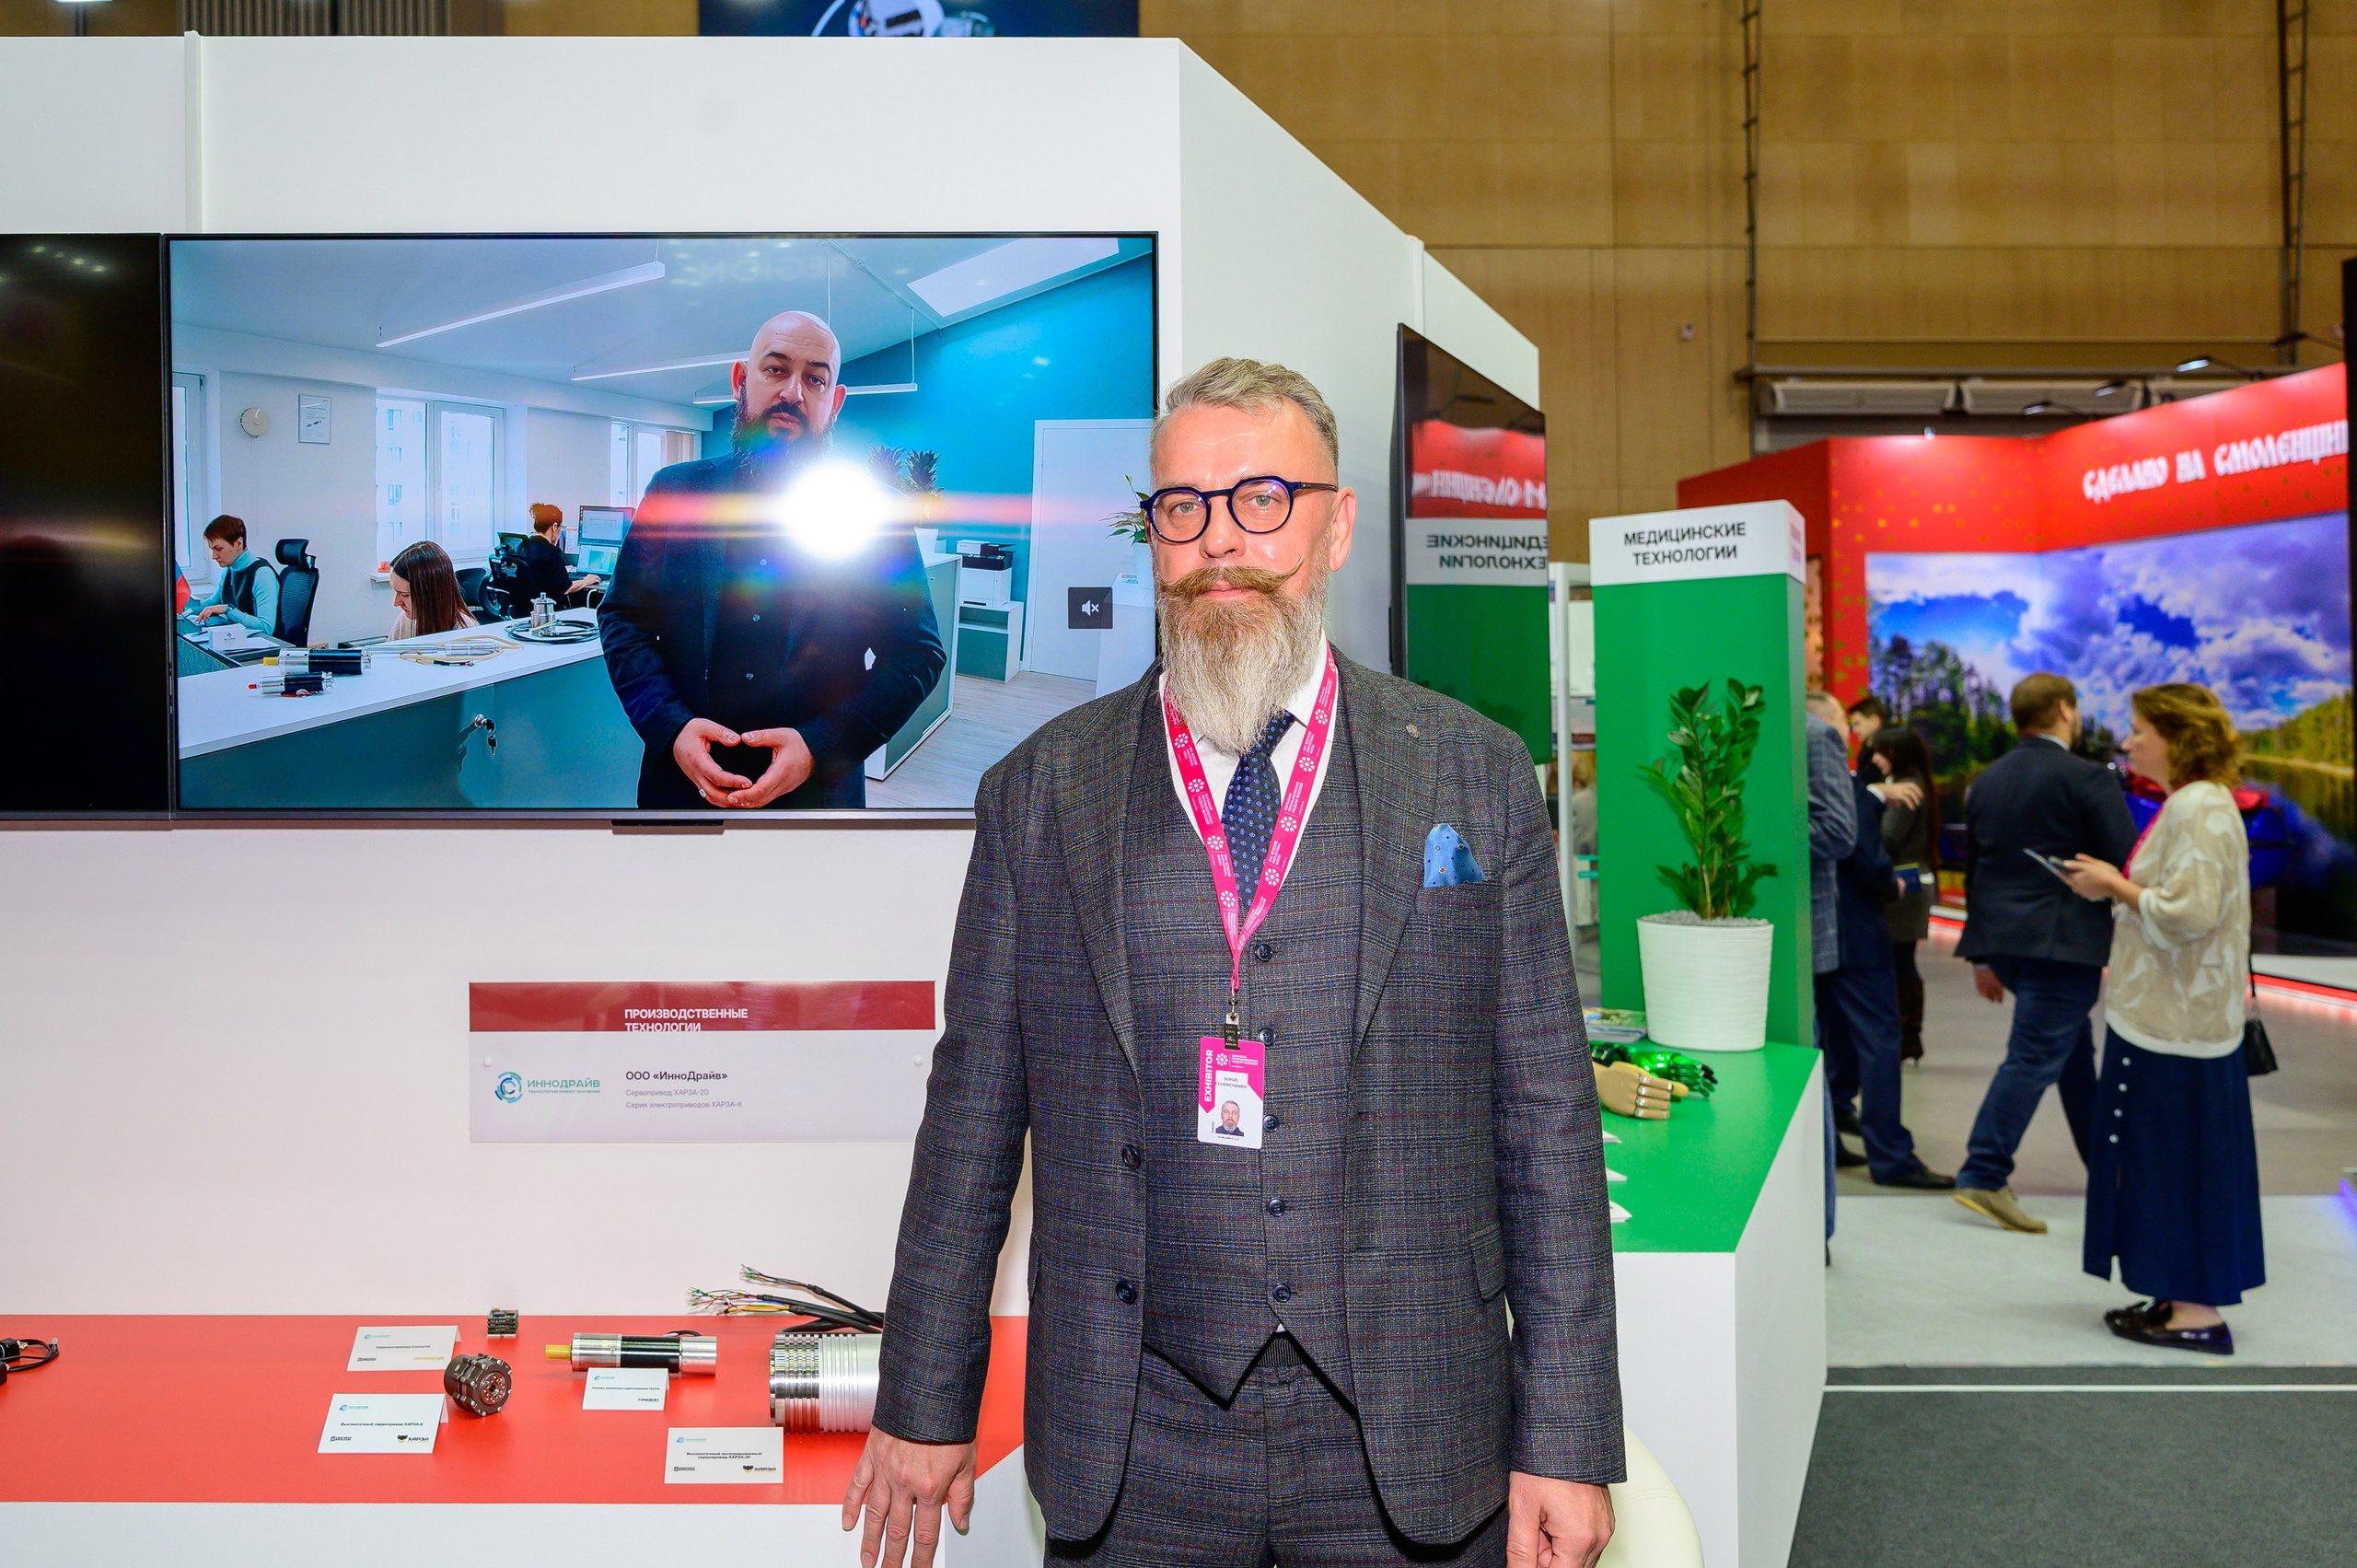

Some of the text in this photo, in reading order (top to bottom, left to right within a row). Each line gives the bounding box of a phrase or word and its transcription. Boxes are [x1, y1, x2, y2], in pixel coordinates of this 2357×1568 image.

[2083, 418, 2349, 505] СДЕЛАНО НА СМОЛЕНЩИН
[1623, 522, 1747, 548] МЕДИЦИНСКИЕ
[1632, 545, 1737, 566] ТЕХНОЛОГИИ
[624, 1008, 749, 1020] ПРОИЗВОДСТВЕННЫЕ
[624, 1022, 702, 1031] ТЕХНОЛОГИИ
[625, 1071, 728, 1082] ООО «ИнноДрайв»
[1204, 1049, 1213, 1102] EXHIBITOR
[527, 1077, 601, 1088] ИННОДРАЙВ
[625, 1088, 673, 1098] Сервопривод
[625, 1100, 743, 1110] Серия электроприводов ХАРЗА-К
